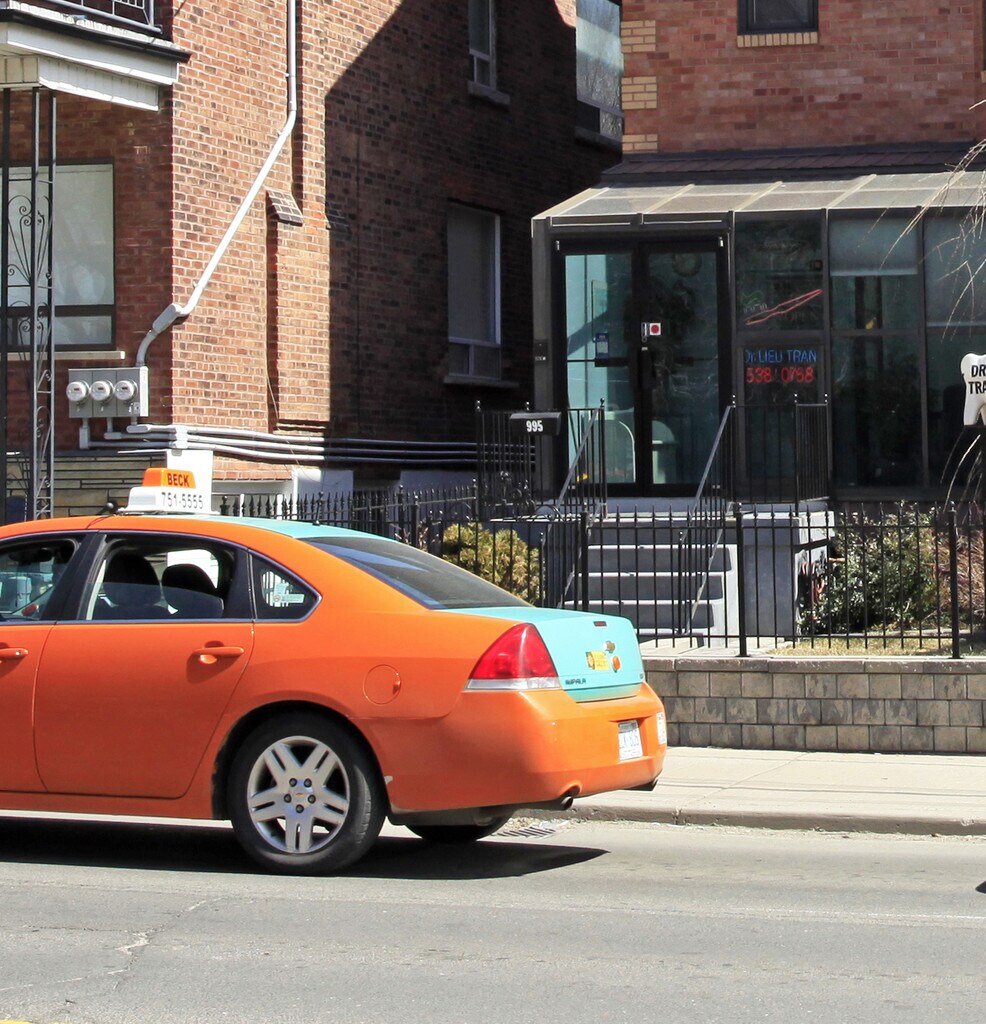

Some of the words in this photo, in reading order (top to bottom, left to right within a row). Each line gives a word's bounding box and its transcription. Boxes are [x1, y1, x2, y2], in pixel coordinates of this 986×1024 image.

[758, 350, 783, 363] LIEU
[787, 350, 817, 363] TRAN
[526, 420, 543, 432] 995
[167, 473, 190, 487] BECK
[161, 492, 203, 509] 751-5555
